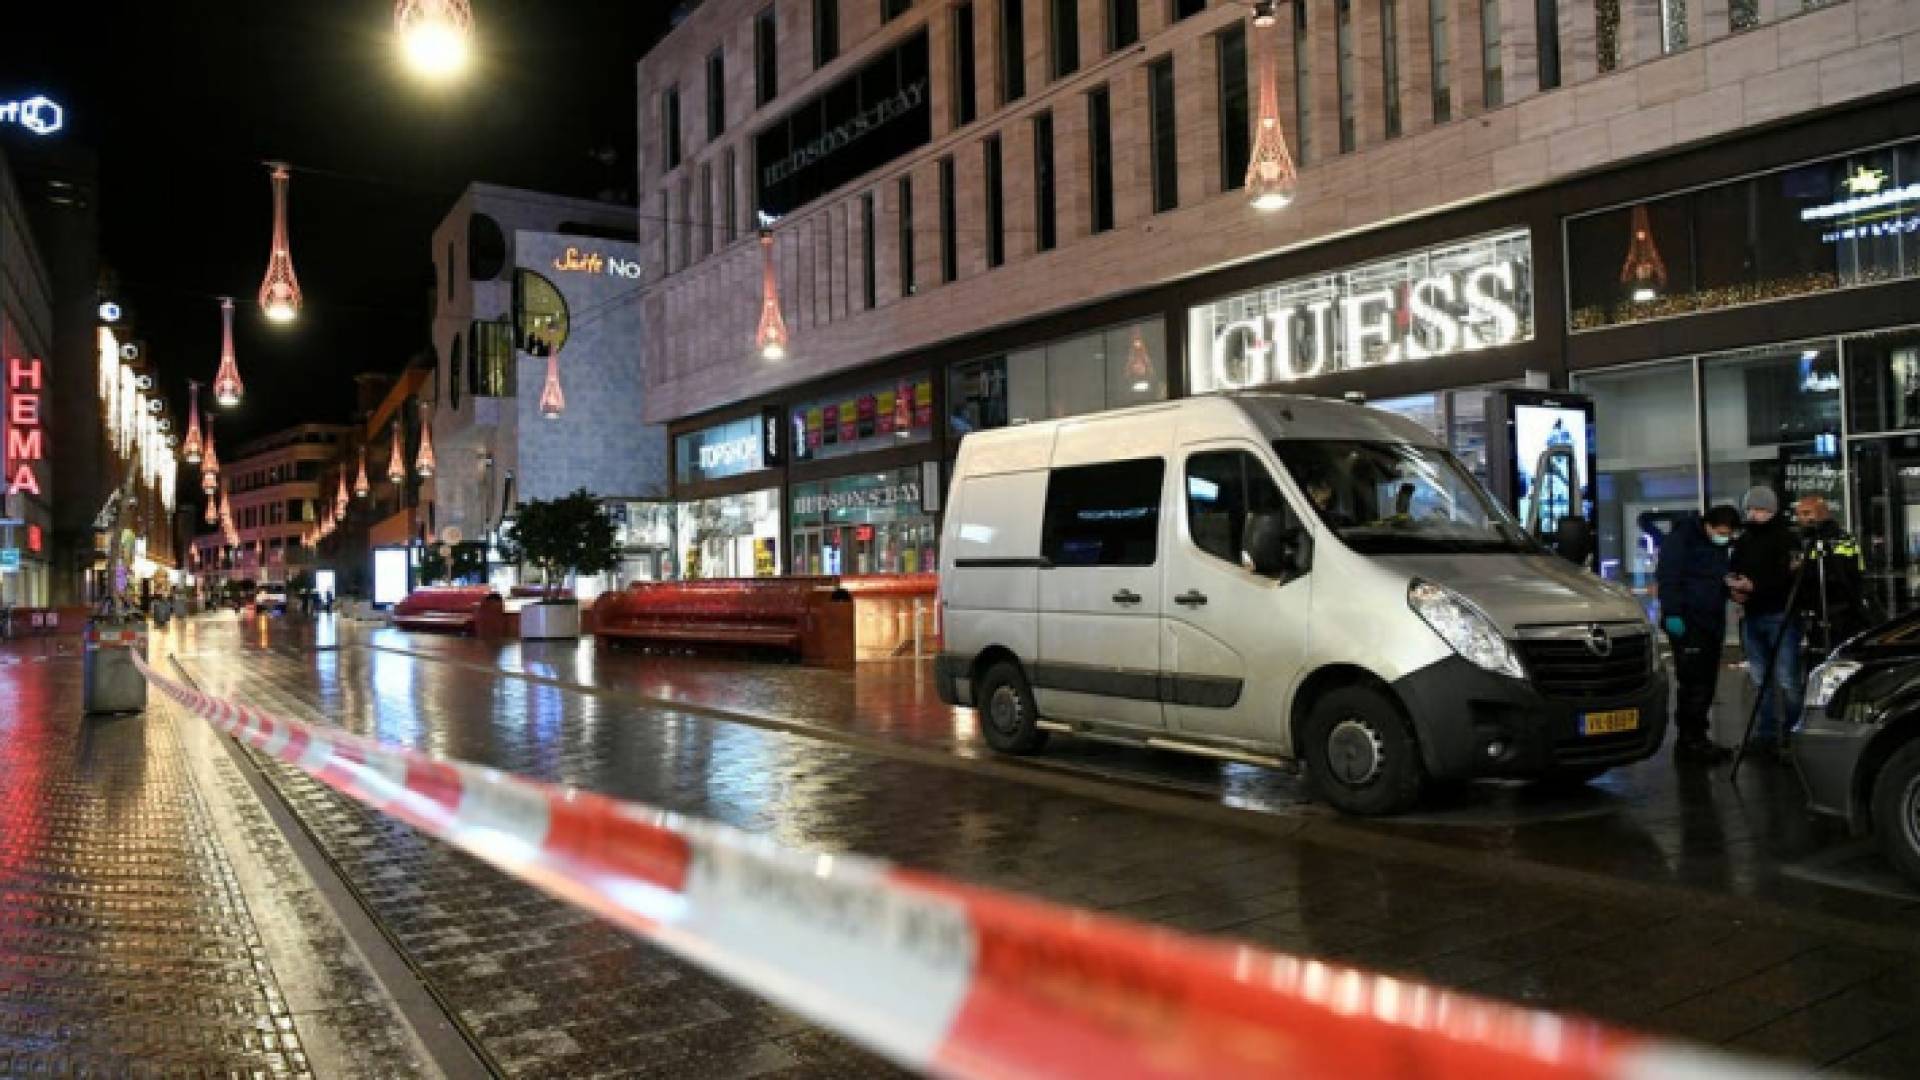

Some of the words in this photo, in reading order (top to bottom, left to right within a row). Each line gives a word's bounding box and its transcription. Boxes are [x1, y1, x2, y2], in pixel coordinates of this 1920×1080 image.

[875, 77, 927, 125] BAY
[1213, 260, 1518, 390] GUESS
[8, 358, 41, 495] HEMA
[885, 482, 919, 504] BAY
